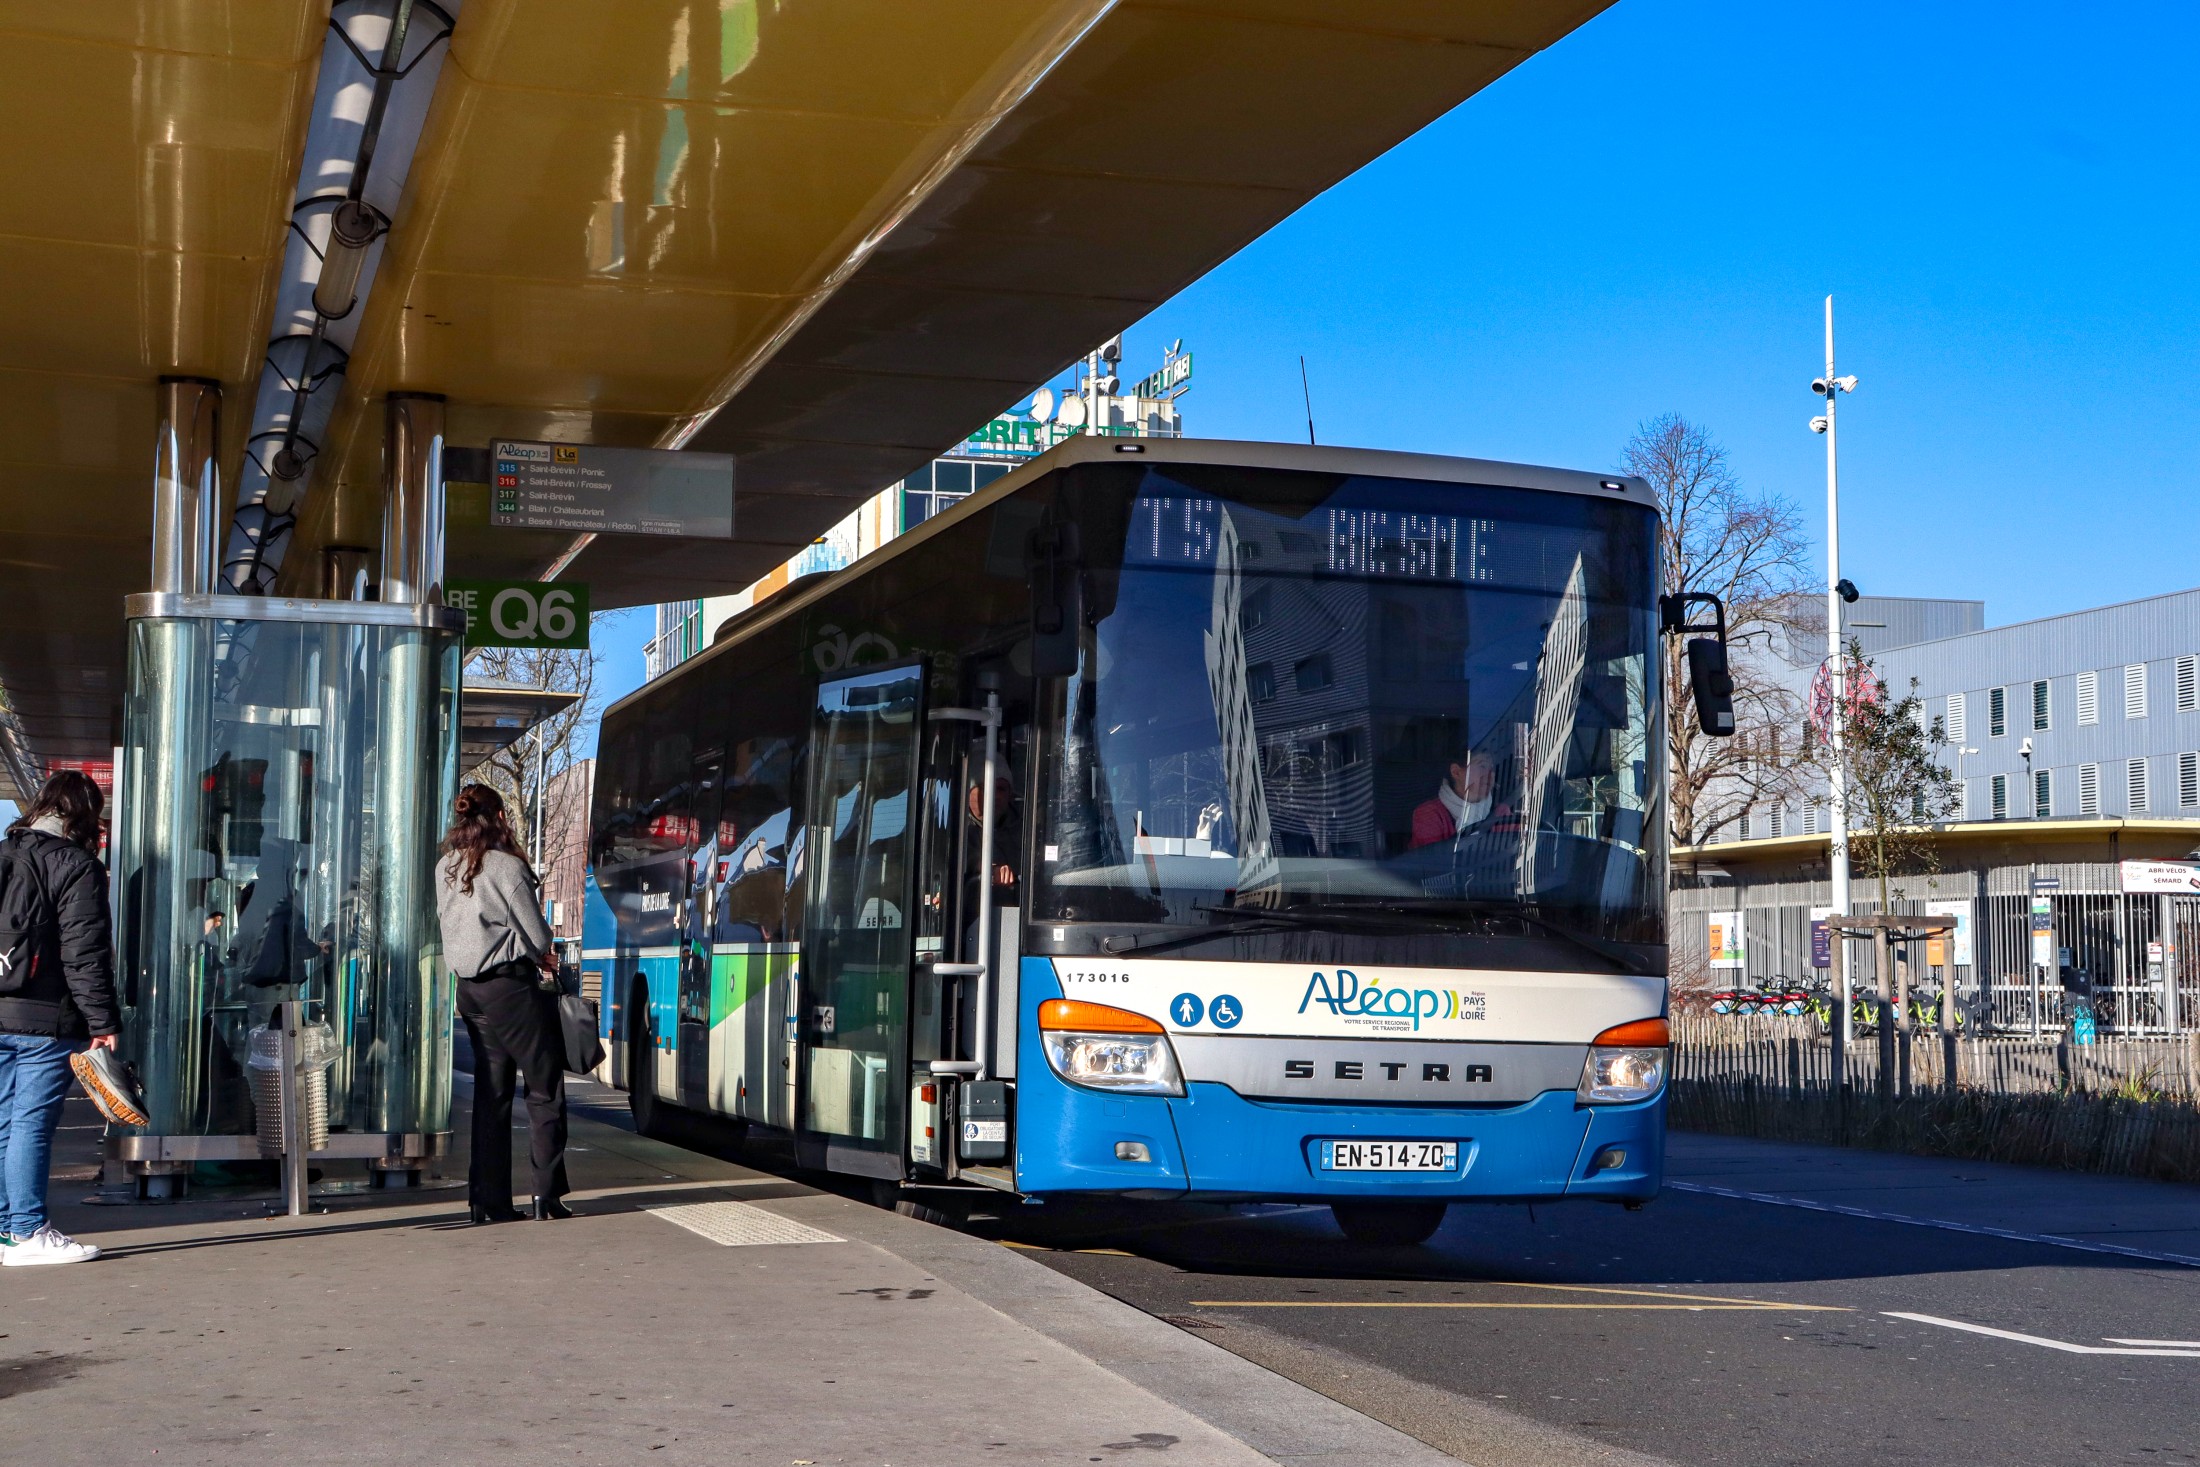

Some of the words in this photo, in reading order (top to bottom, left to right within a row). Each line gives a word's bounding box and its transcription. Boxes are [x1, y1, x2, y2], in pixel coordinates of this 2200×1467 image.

[499, 464, 516, 472] 315
[581, 467, 605, 477] Pornic
[499, 478, 516, 486] 316
[581, 481, 612, 491] Frossay
[499, 490, 515, 498] 317
[499, 503, 515, 511] 344
[528, 504, 547, 513] Blain
[612, 522, 636, 531] Redon
[490, 588, 576, 640] Q6
[866, 916, 893, 927] SERA
[1066, 973, 1130, 983] 173016
[1298, 969, 1438, 1031] Aléop
[1463, 996, 1485, 1006] PAYS
[1460, 1011, 1485, 1020] LOIRE
[1285, 1060, 1493, 1083] SETRA
[1445, 1157, 1455, 1167] 44
